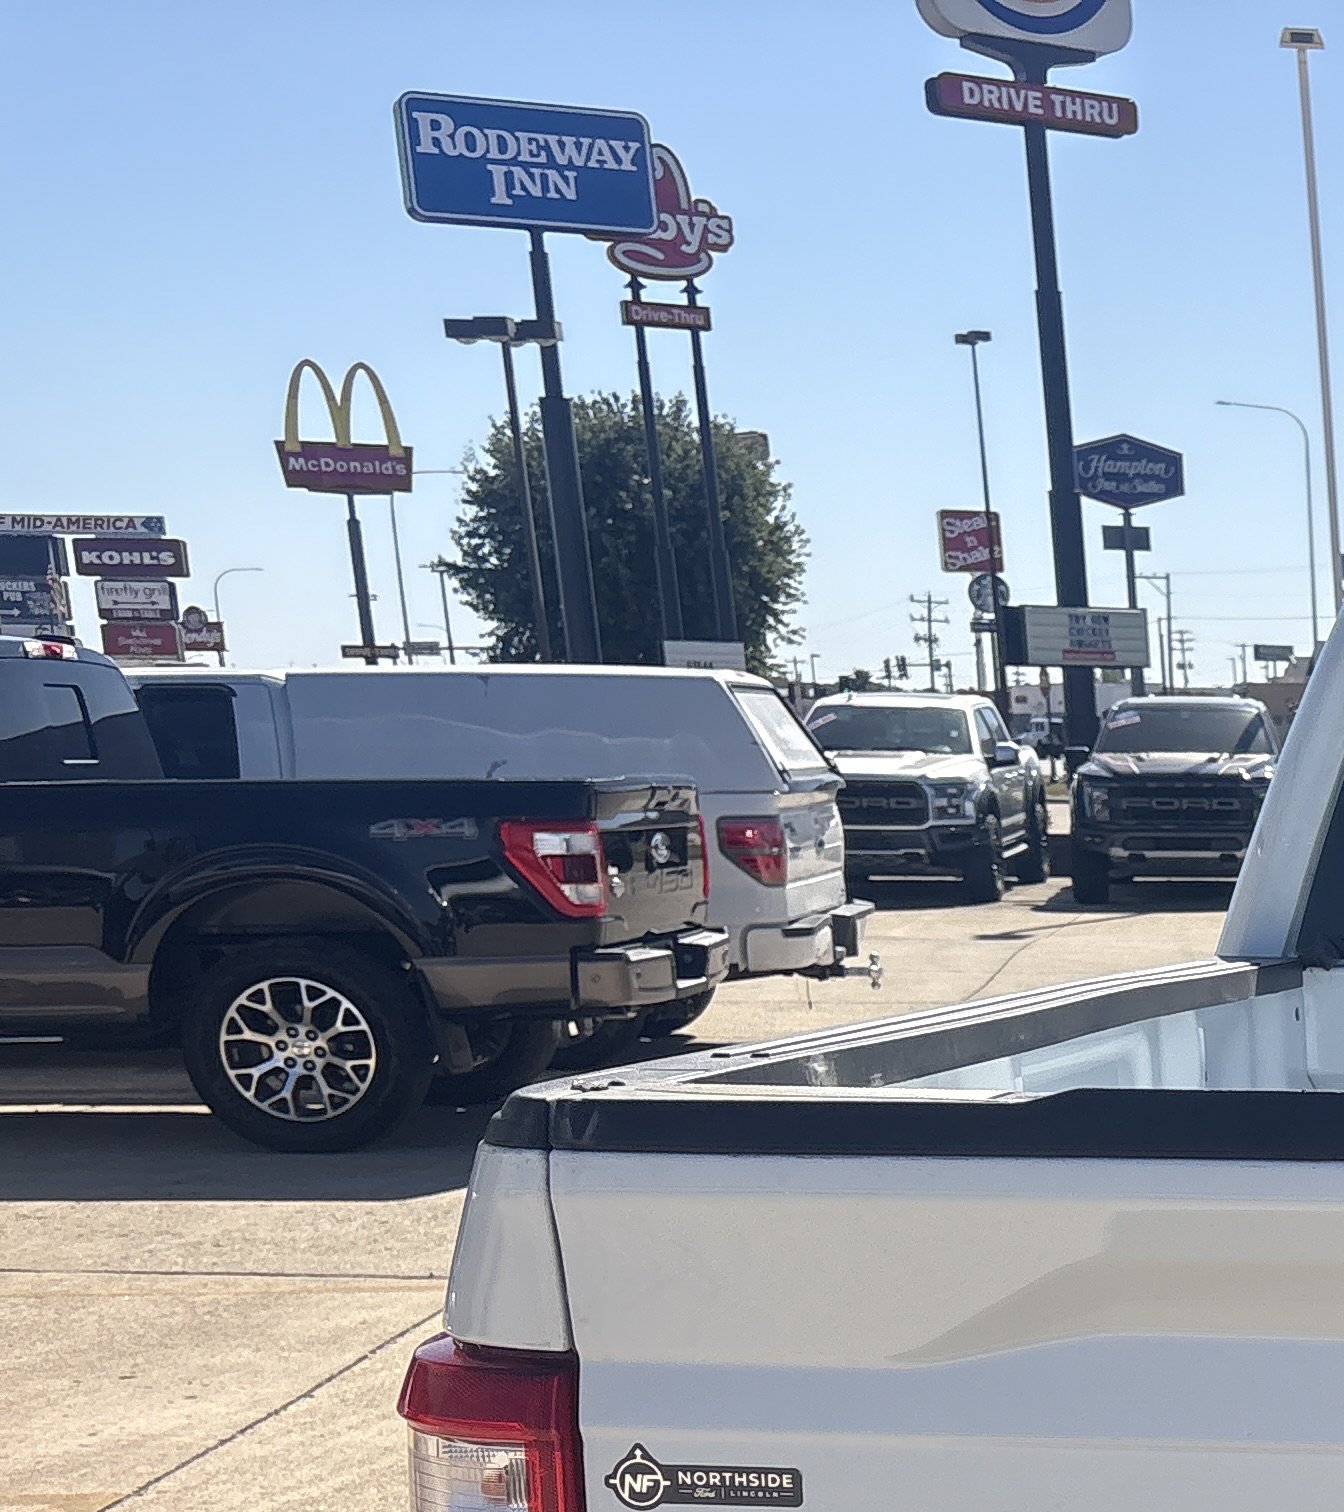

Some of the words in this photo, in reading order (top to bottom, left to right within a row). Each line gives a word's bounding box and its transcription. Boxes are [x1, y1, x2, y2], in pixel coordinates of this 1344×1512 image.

[961, 81, 1044, 116] DRIVE
[1050, 94, 1119, 126] THRU
[412, 111, 642, 172] RODEWAY
[486, 163, 578, 206] INN
[631, 304, 705, 326] Drive-Thru
[288, 456, 407, 476] McDonald's
[1079, 454, 1175, 478] Hampton
[11, 516, 137, 531] MID-AMERICA
[81, 550, 176, 566] KOHL'S
[1121, 798, 1241, 811] FORD
[677, 1471, 794, 1488] NORTHSIDE
